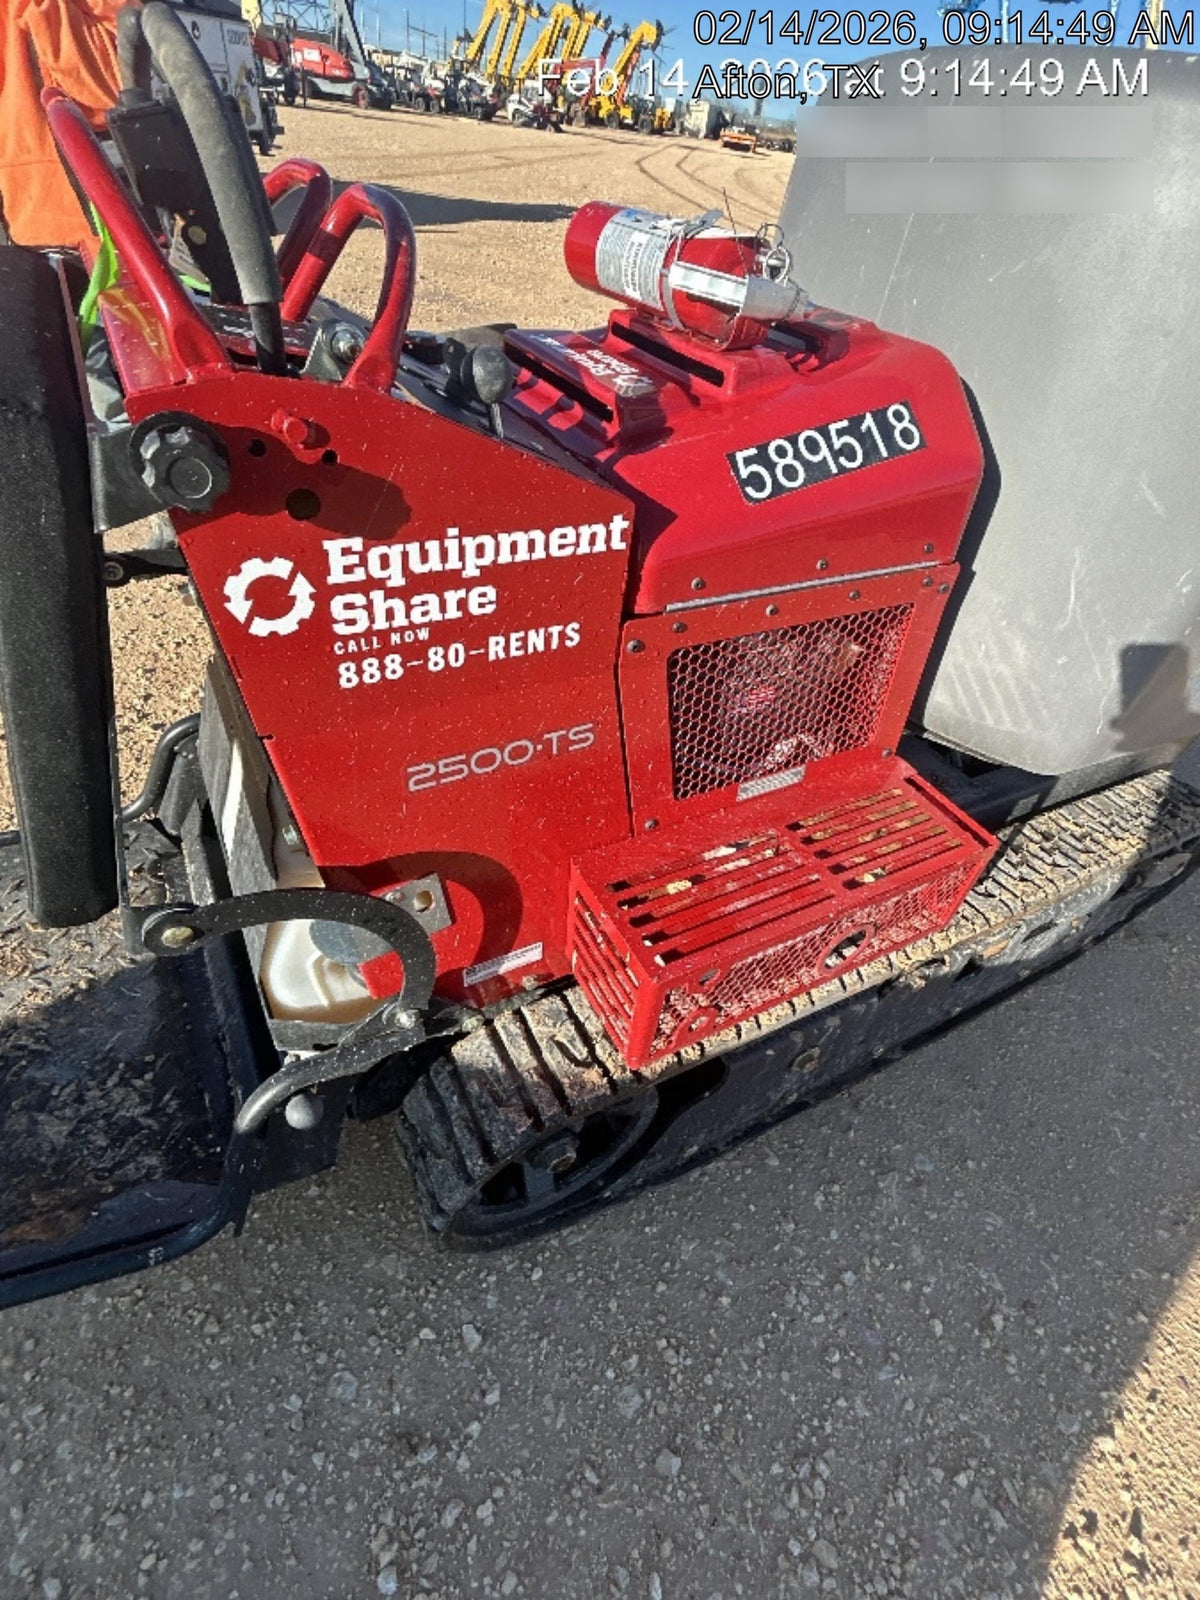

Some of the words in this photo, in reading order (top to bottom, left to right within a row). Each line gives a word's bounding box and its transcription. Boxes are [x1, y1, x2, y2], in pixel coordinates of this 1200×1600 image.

[734, 402, 922, 501] 589518
[322, 516, 629, 586] Equipment
[330, 584, 496, 635] Share
[332, 637, 384, 656] CALL
[389, 626, 431, 646] NOW
[337, 621, 582, 690] 888-80-RENTS
